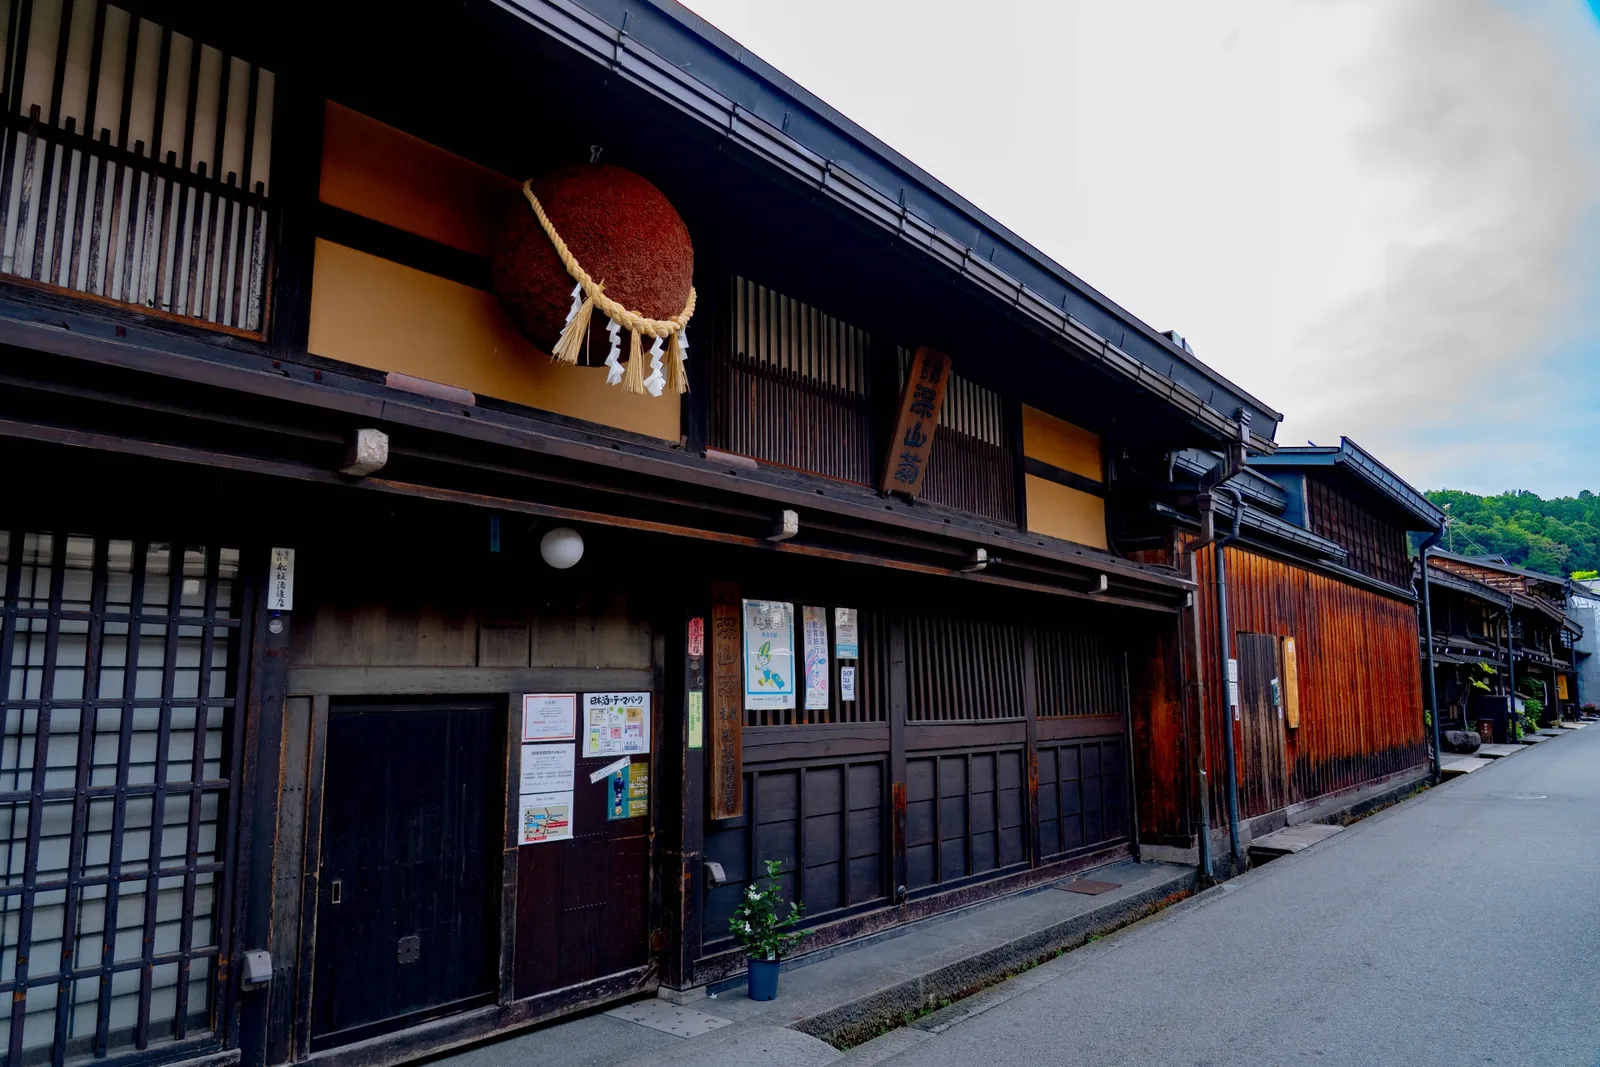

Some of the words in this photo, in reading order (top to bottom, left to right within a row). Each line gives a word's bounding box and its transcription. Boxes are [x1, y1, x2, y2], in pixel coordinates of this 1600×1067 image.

[590, 695, 643, 706] 日本酒のテーマパーク
